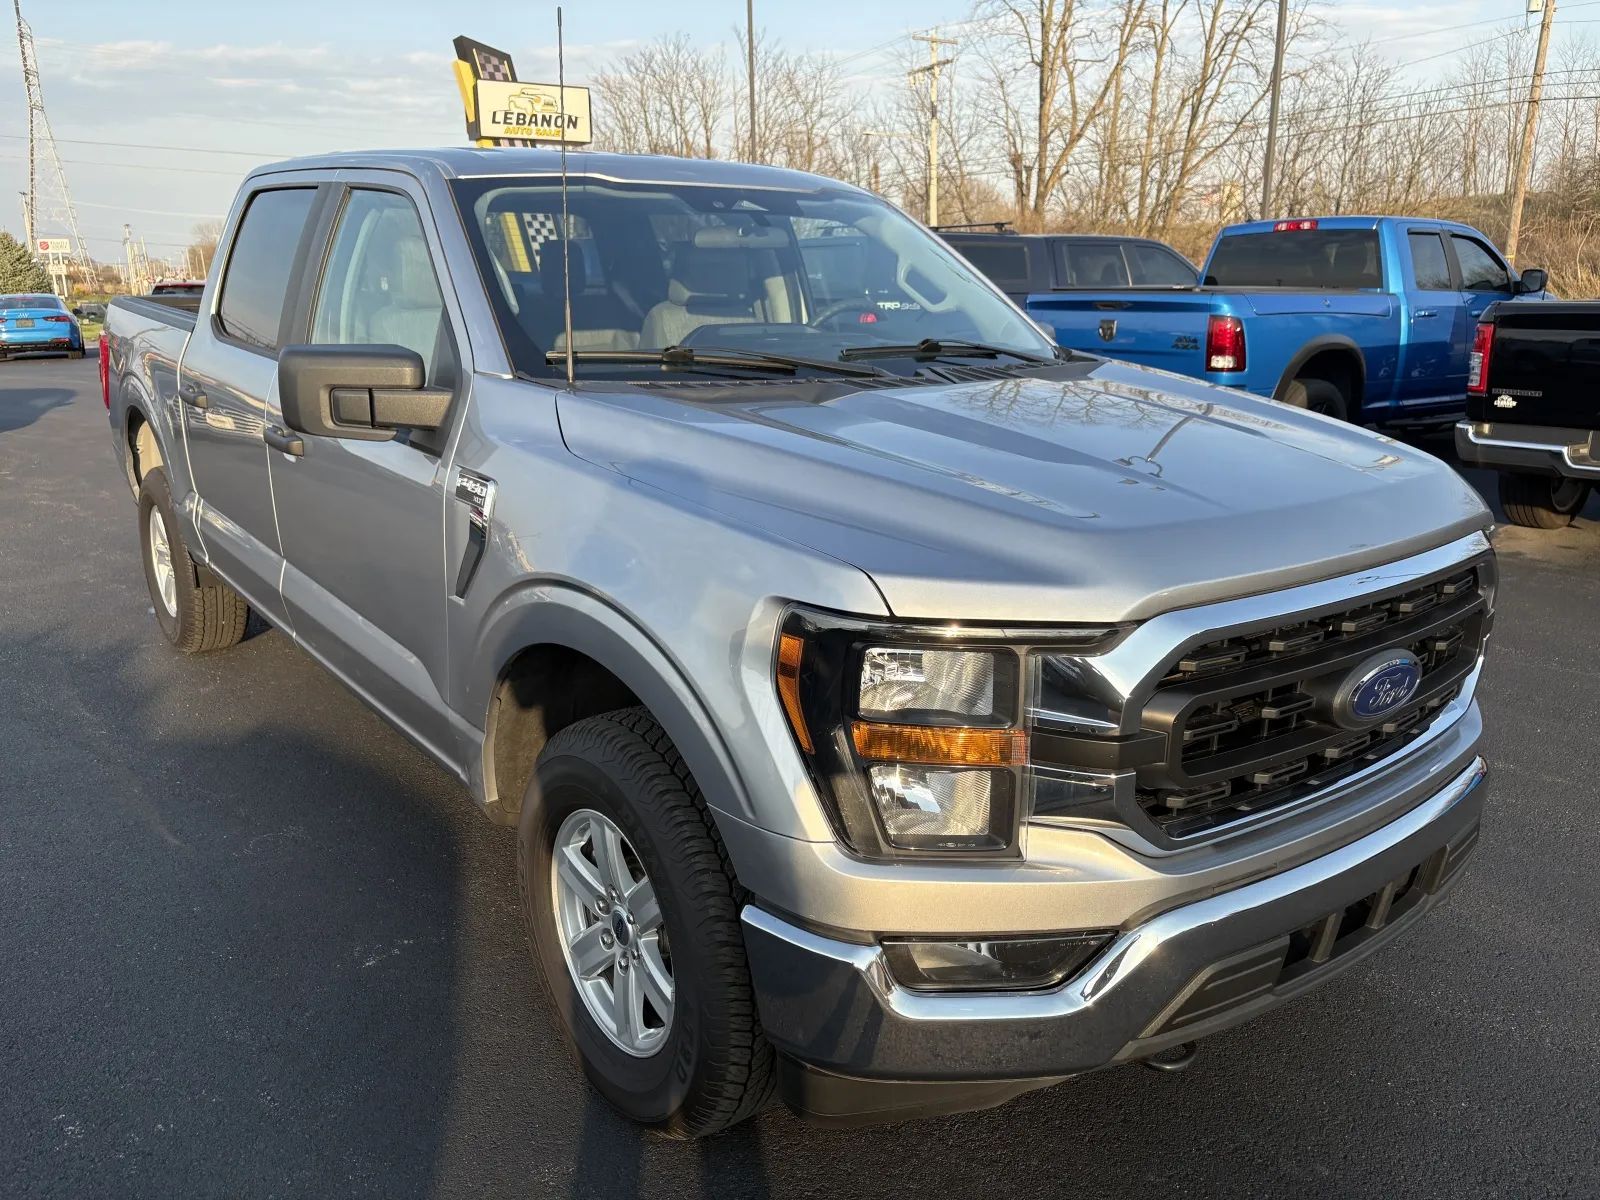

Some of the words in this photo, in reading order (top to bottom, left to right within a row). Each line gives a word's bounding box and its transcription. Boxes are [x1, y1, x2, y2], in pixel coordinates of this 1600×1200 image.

[491, 111, 578, 129] LEBANON
[504, 127, 533, 136] AUTO
[1369, 673, 1410, 710] Ford
